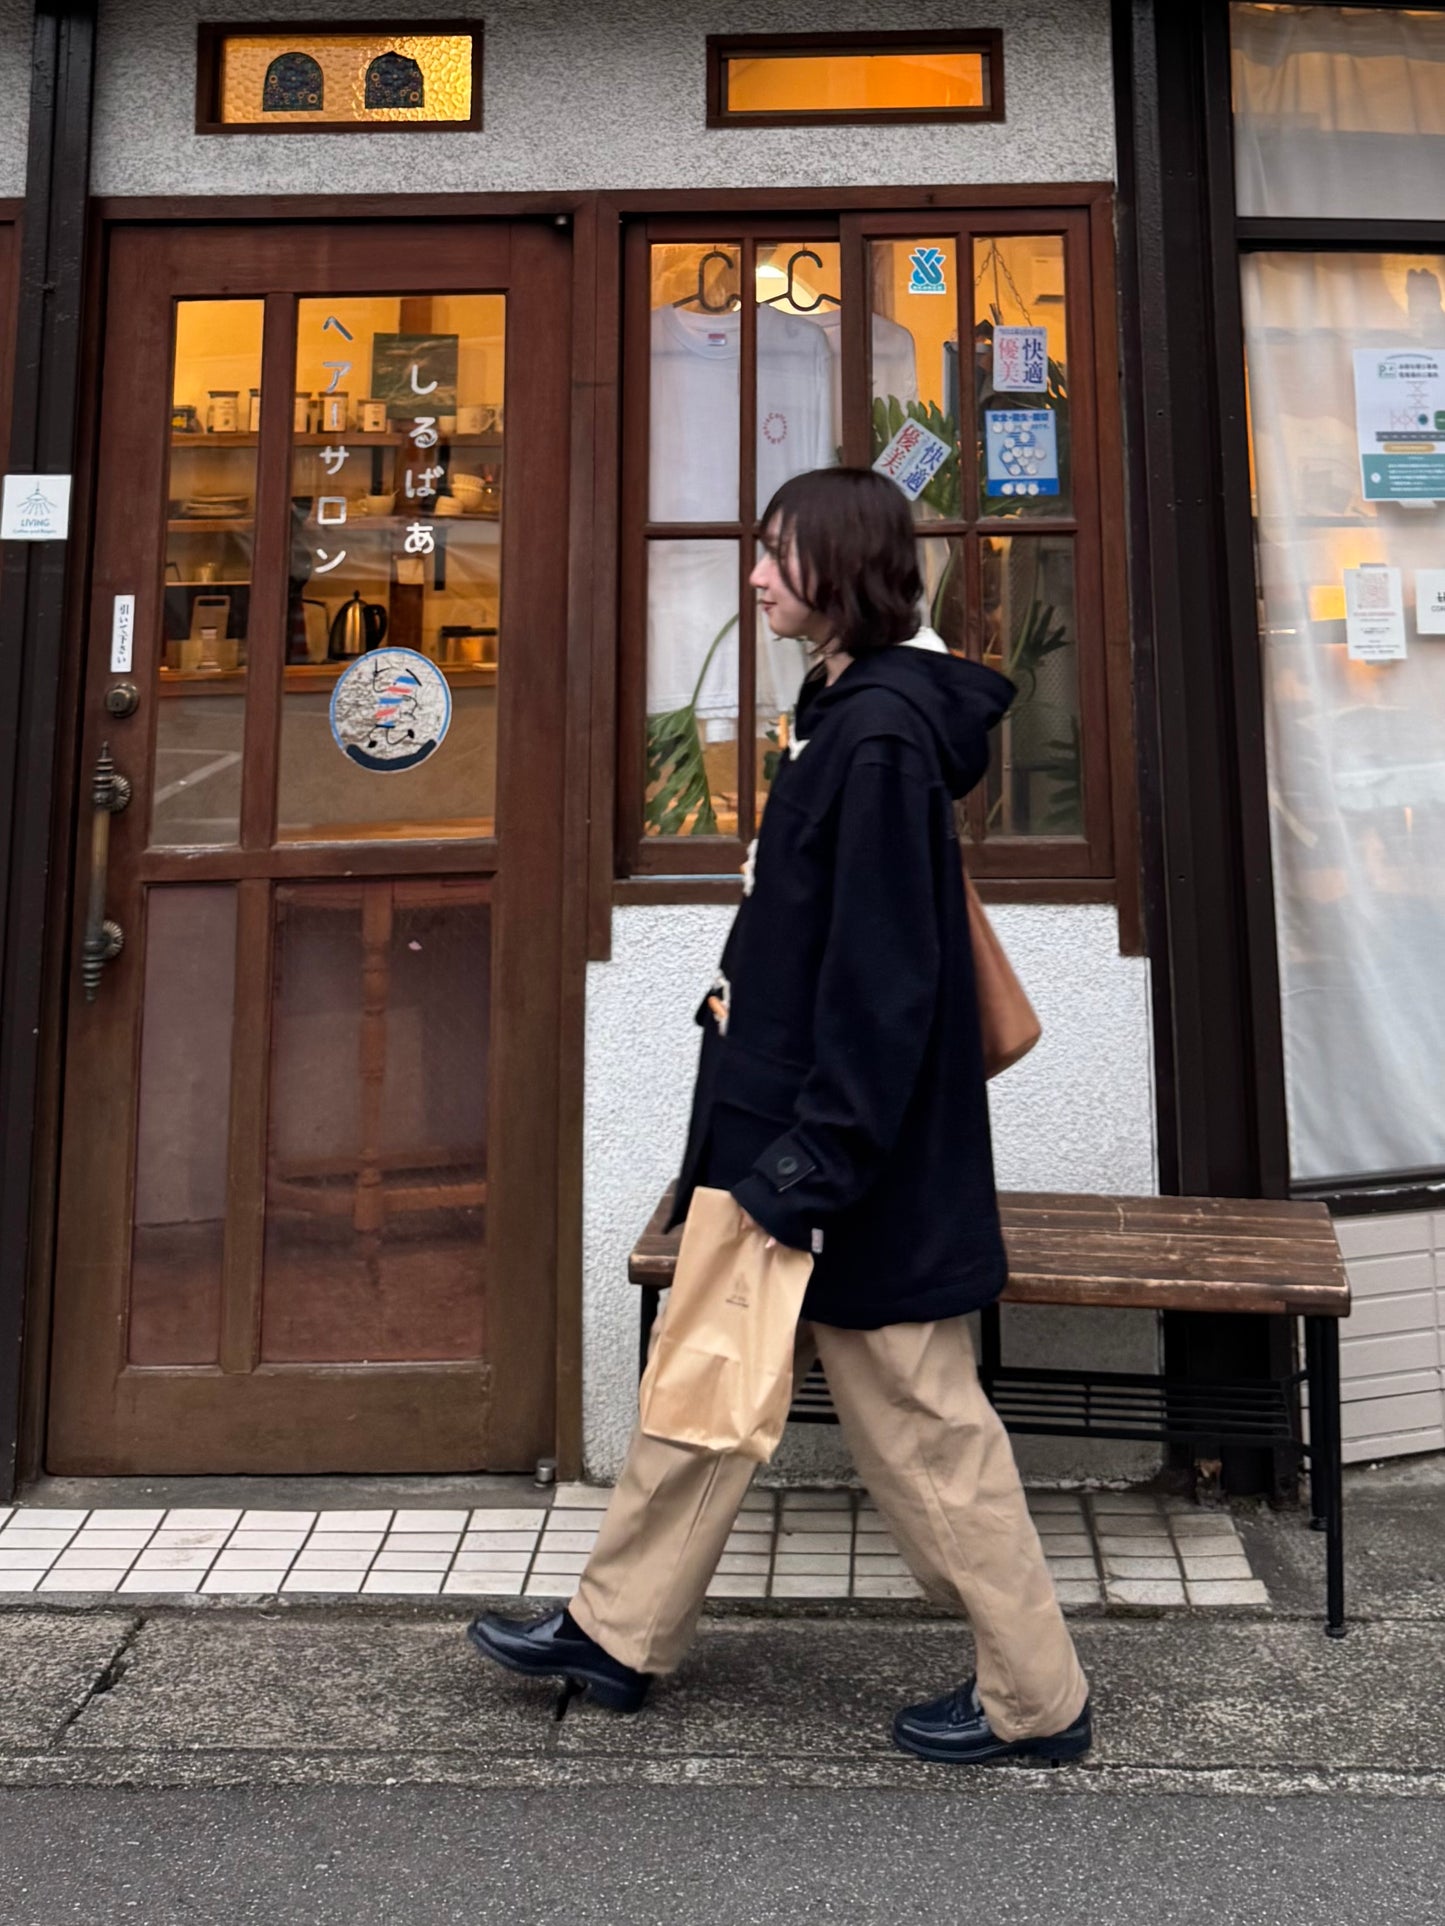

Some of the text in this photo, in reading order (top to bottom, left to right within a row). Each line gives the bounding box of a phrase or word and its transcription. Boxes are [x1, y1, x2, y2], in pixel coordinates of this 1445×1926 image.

[998, 337, 1020, 384] 優美
[1021, 338, 1044, 385] 快適
[314, 316, 353, 574] ヘアーサロン
[403, 364, 445, 555] しるばあ
[880, 423, 922, 475] 優美
[902, 441, 944, 493] 快適
[21, 518, 51, 527] LIVING
